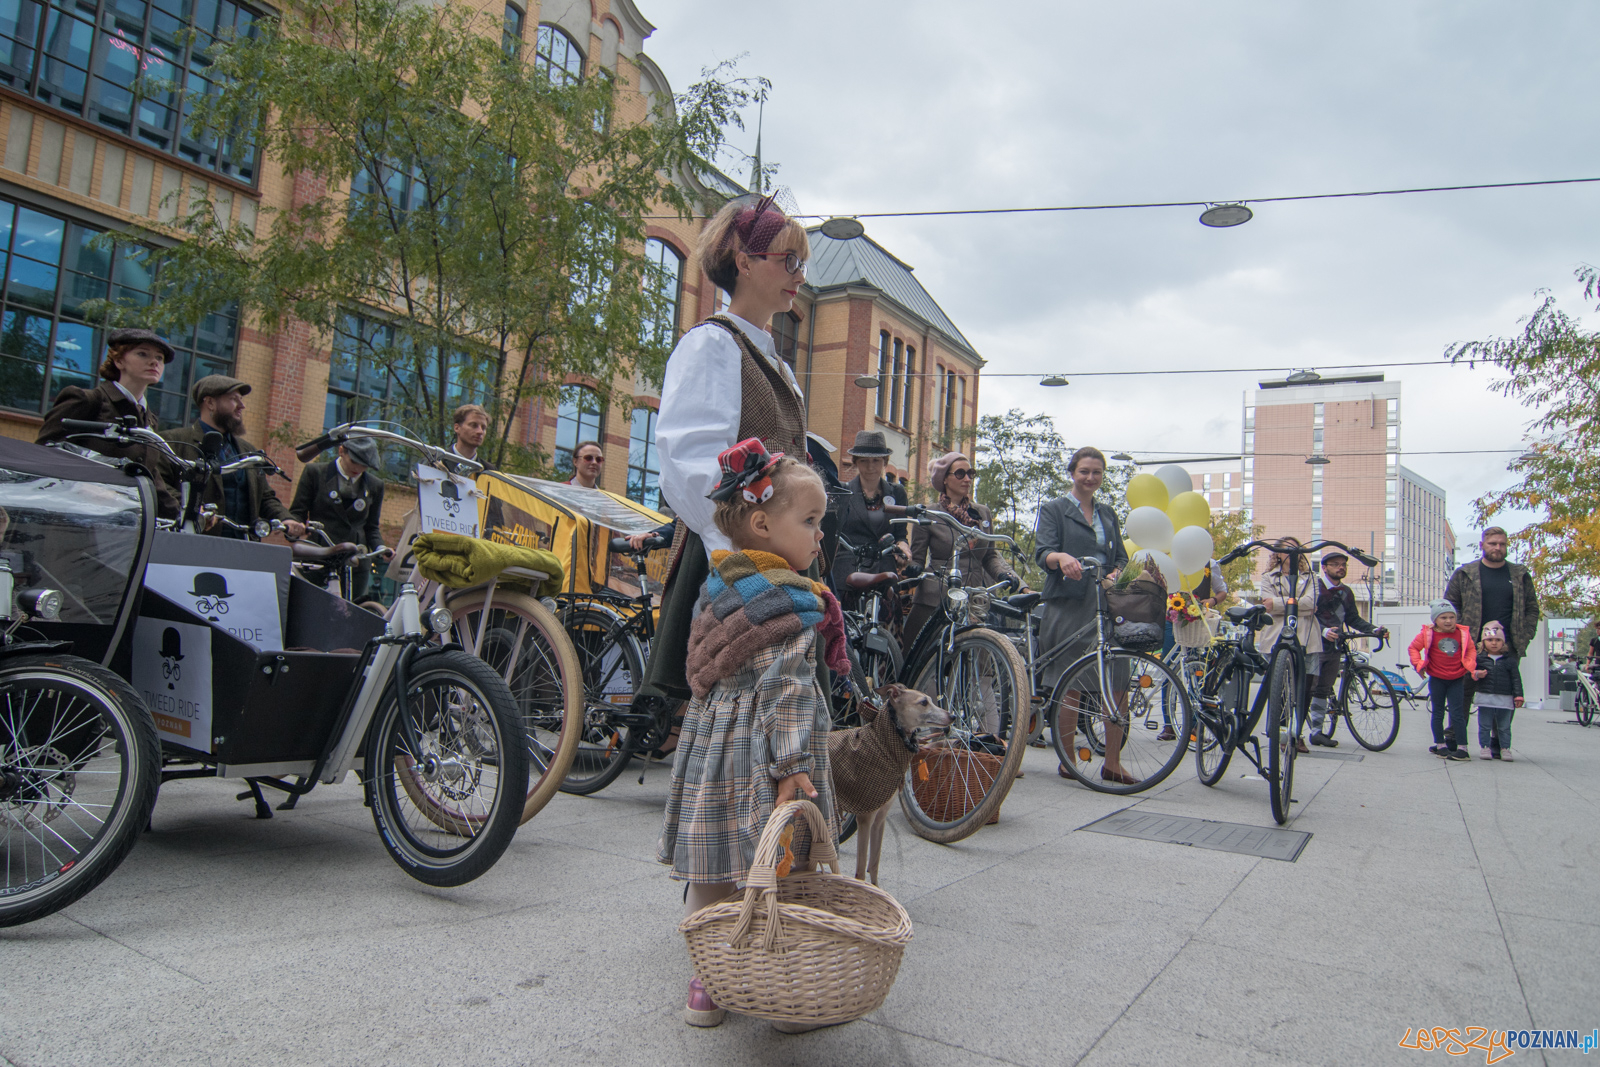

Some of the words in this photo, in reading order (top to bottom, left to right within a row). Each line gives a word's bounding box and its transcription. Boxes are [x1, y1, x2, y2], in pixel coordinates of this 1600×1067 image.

[426, 515, 458, 532] TWEED
[144, 690, 176, 713] TWEED
[178, 699, 200, 720] RIDE
